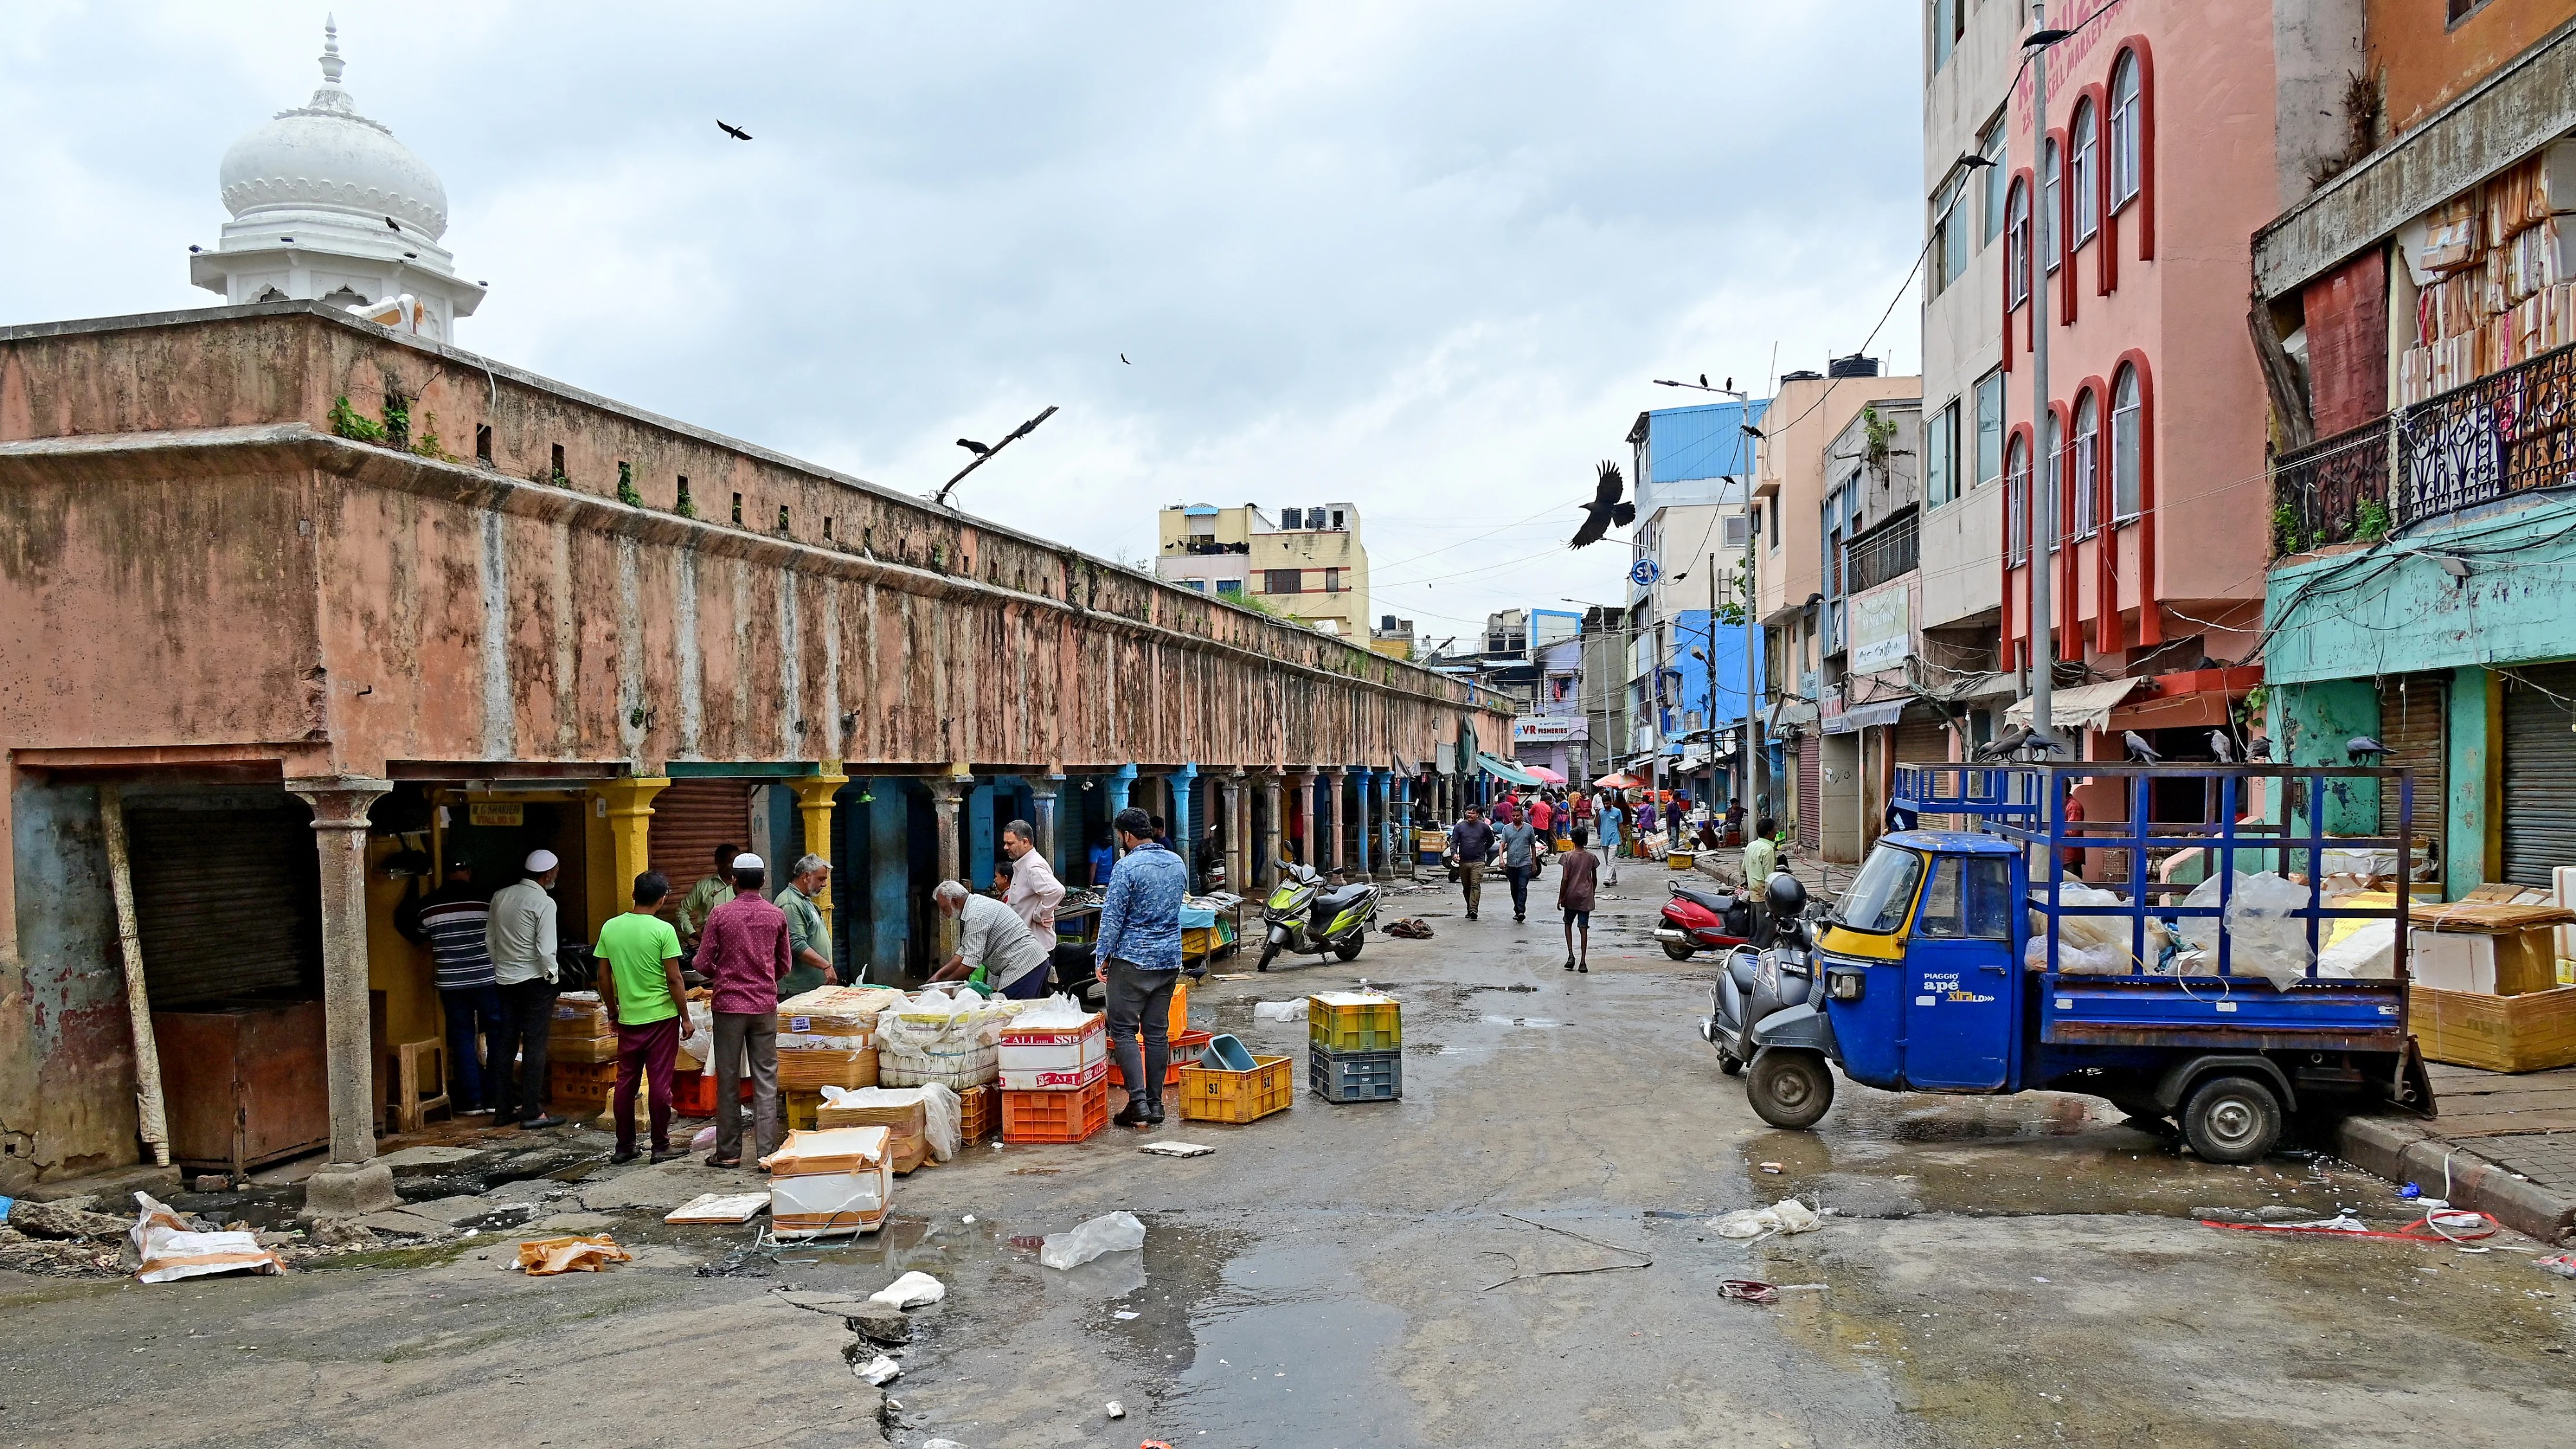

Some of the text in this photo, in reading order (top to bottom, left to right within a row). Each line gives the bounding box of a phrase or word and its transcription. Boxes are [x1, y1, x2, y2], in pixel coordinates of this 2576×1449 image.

[1522, 725, 1536, 734] VR
[1924, 980, 1959, 993] apé
[1208, 1083, 1219, 1094] SI
